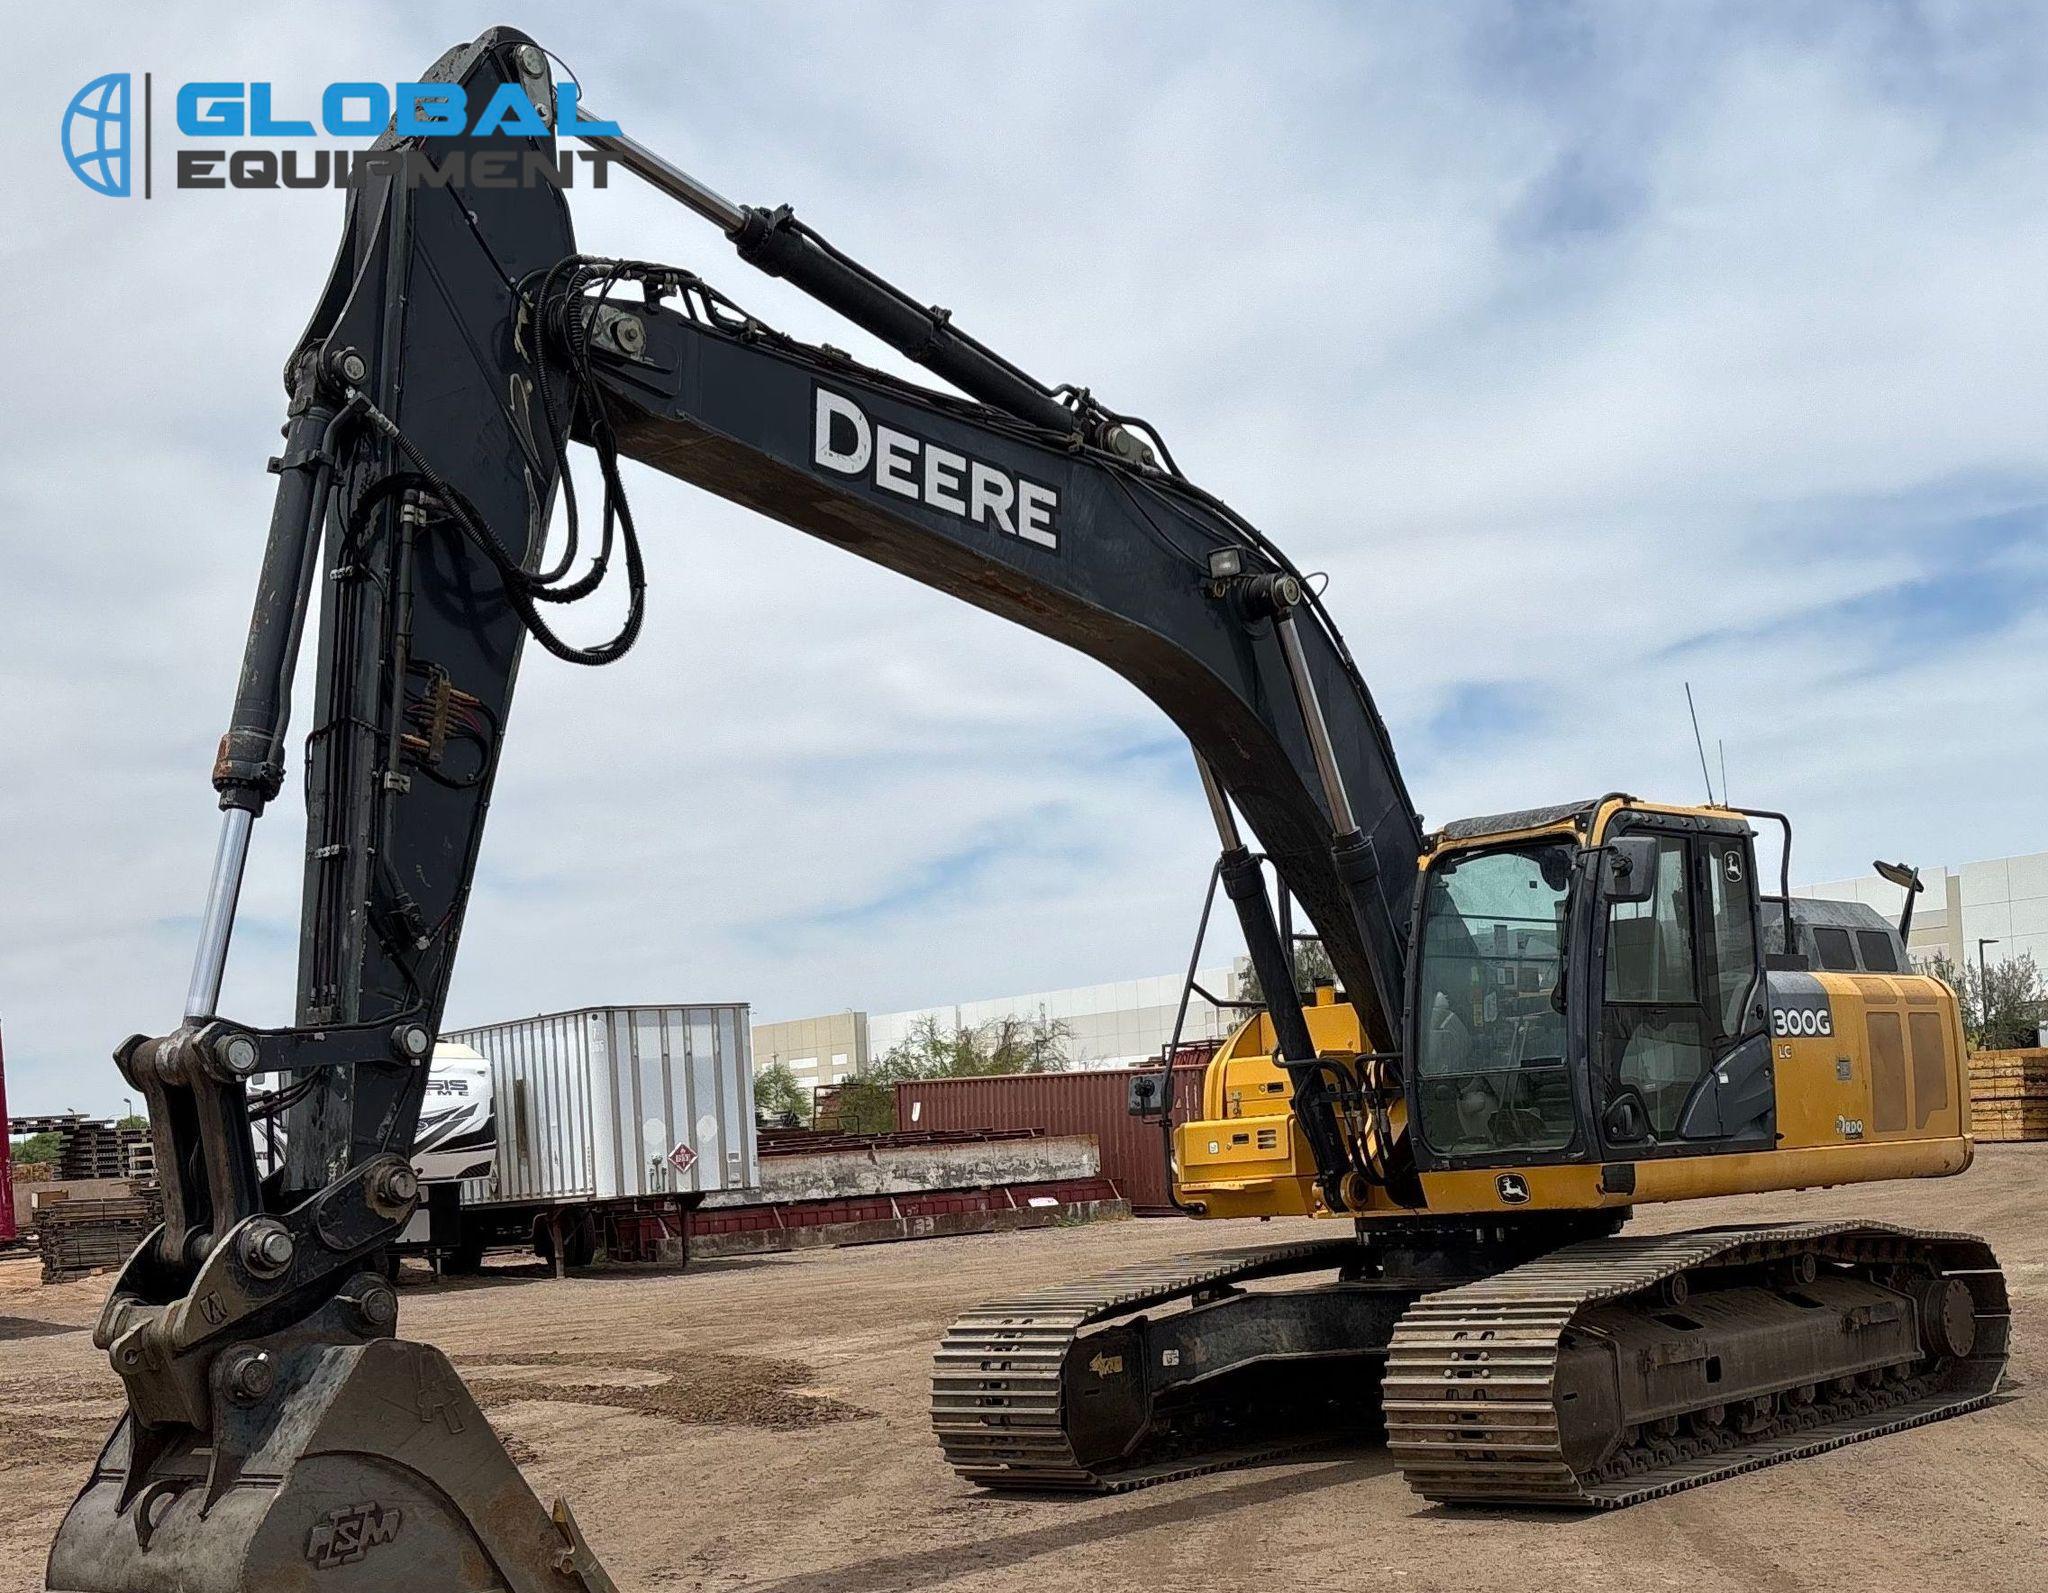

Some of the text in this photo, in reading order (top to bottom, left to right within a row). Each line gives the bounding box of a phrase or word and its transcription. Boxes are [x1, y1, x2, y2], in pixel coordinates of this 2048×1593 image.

[815, 387, 1056, 549] DEERE
[1773, 1009, 1831, 1035] 300G
[1778, 1045, 1792, 1059] LC
